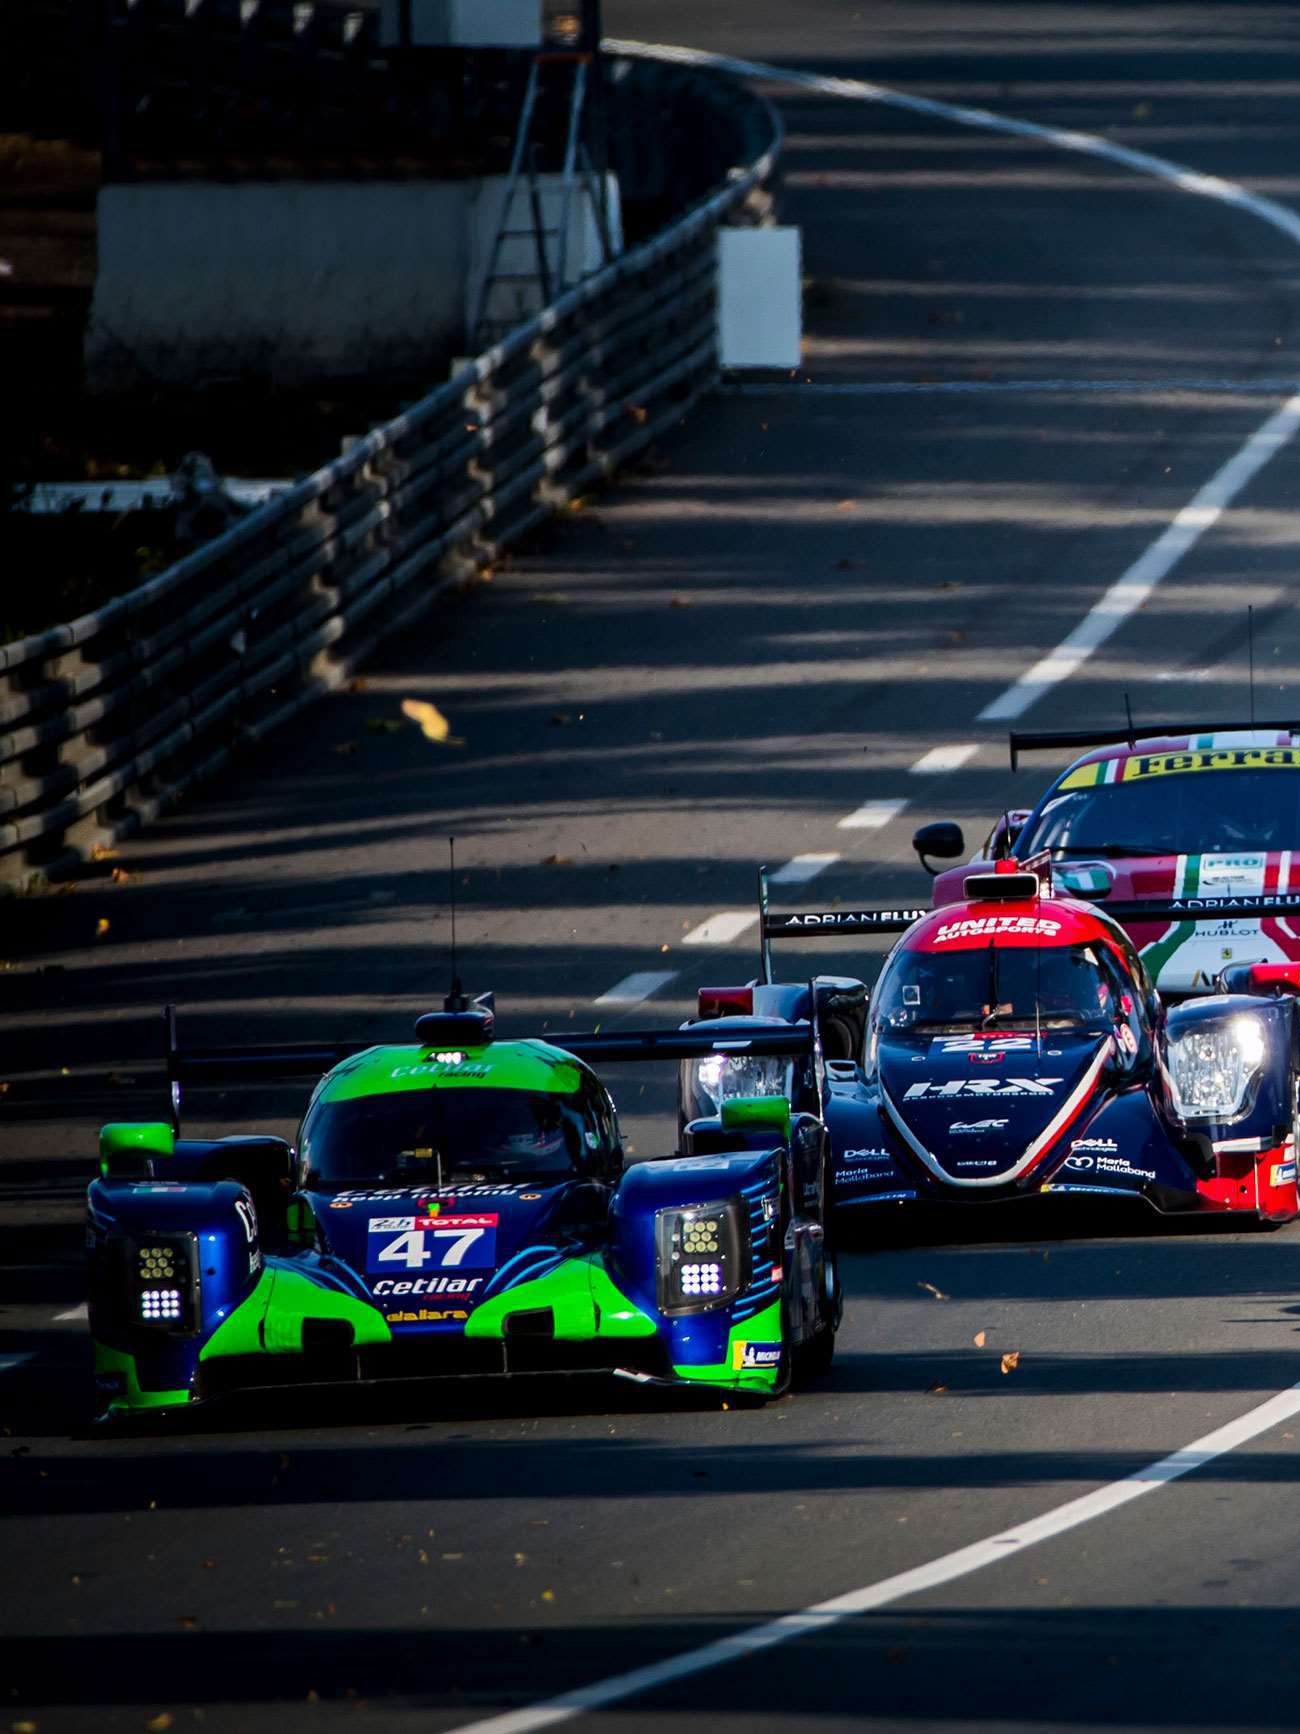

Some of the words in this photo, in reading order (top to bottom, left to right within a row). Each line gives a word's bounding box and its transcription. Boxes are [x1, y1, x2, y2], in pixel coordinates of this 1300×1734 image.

[937, 917, 1061, 935] UNITED
[1194, 929, 1259, 937] HUBLOT
[933, 926, 1057, 943] AUTOSPORTS
[942, 1038, 1032, 1052] 22
[904, 1078, 1064, 1097] HRX
[1071, 1138, 1118, 1147] DELL
[844, 1148, 890, 1158] DELL
[418, 1217, 493, 1226] TOTAL
[378, 1228, 485, 1268] 47
[372, 1277, 483, 1295] Cetilar
[386, 1309, 469, 1322] dallara
